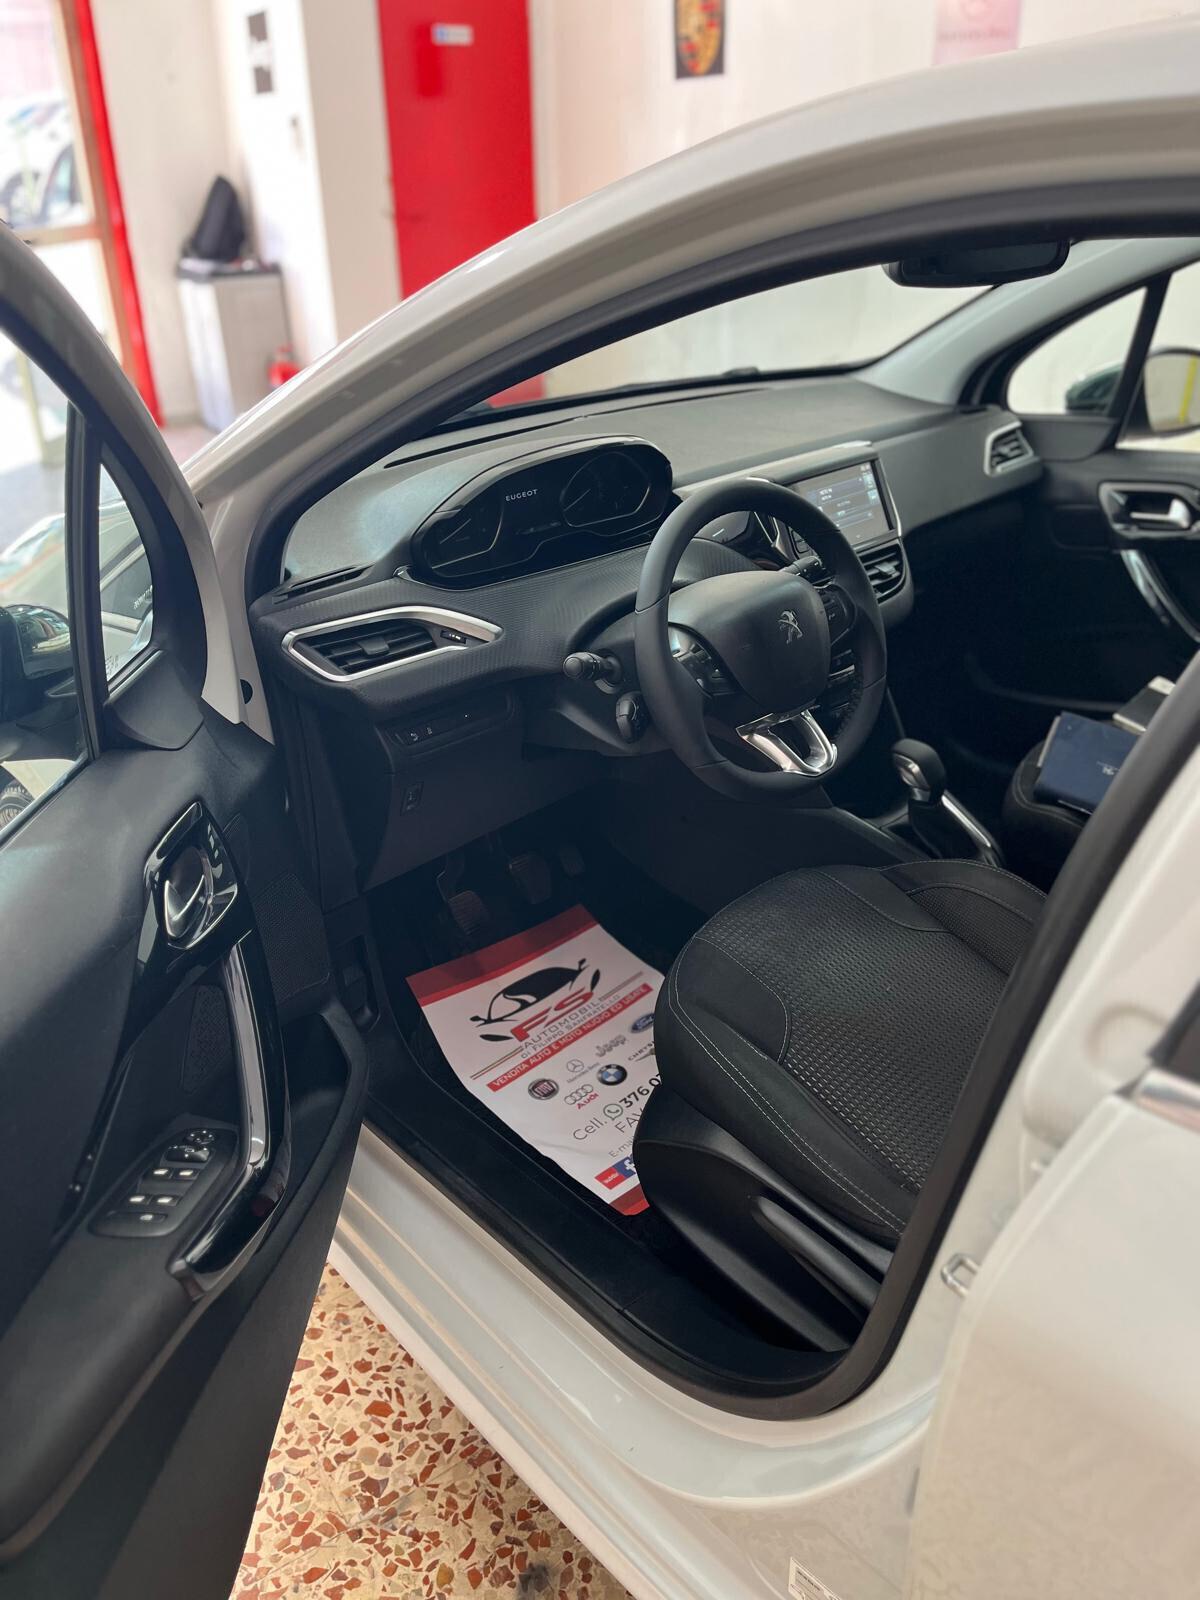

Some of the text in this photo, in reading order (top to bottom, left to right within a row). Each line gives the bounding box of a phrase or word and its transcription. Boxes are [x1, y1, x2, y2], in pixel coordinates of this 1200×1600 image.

[492, 1063, 530, 1087] VENDITA
[529, 1048, 551, 1065] AUTO
[558, 1029, 582, 1047] MOTO
[573, 1117, 608, 1141] Cell.
[619, 1086, 650, 1109] 376
